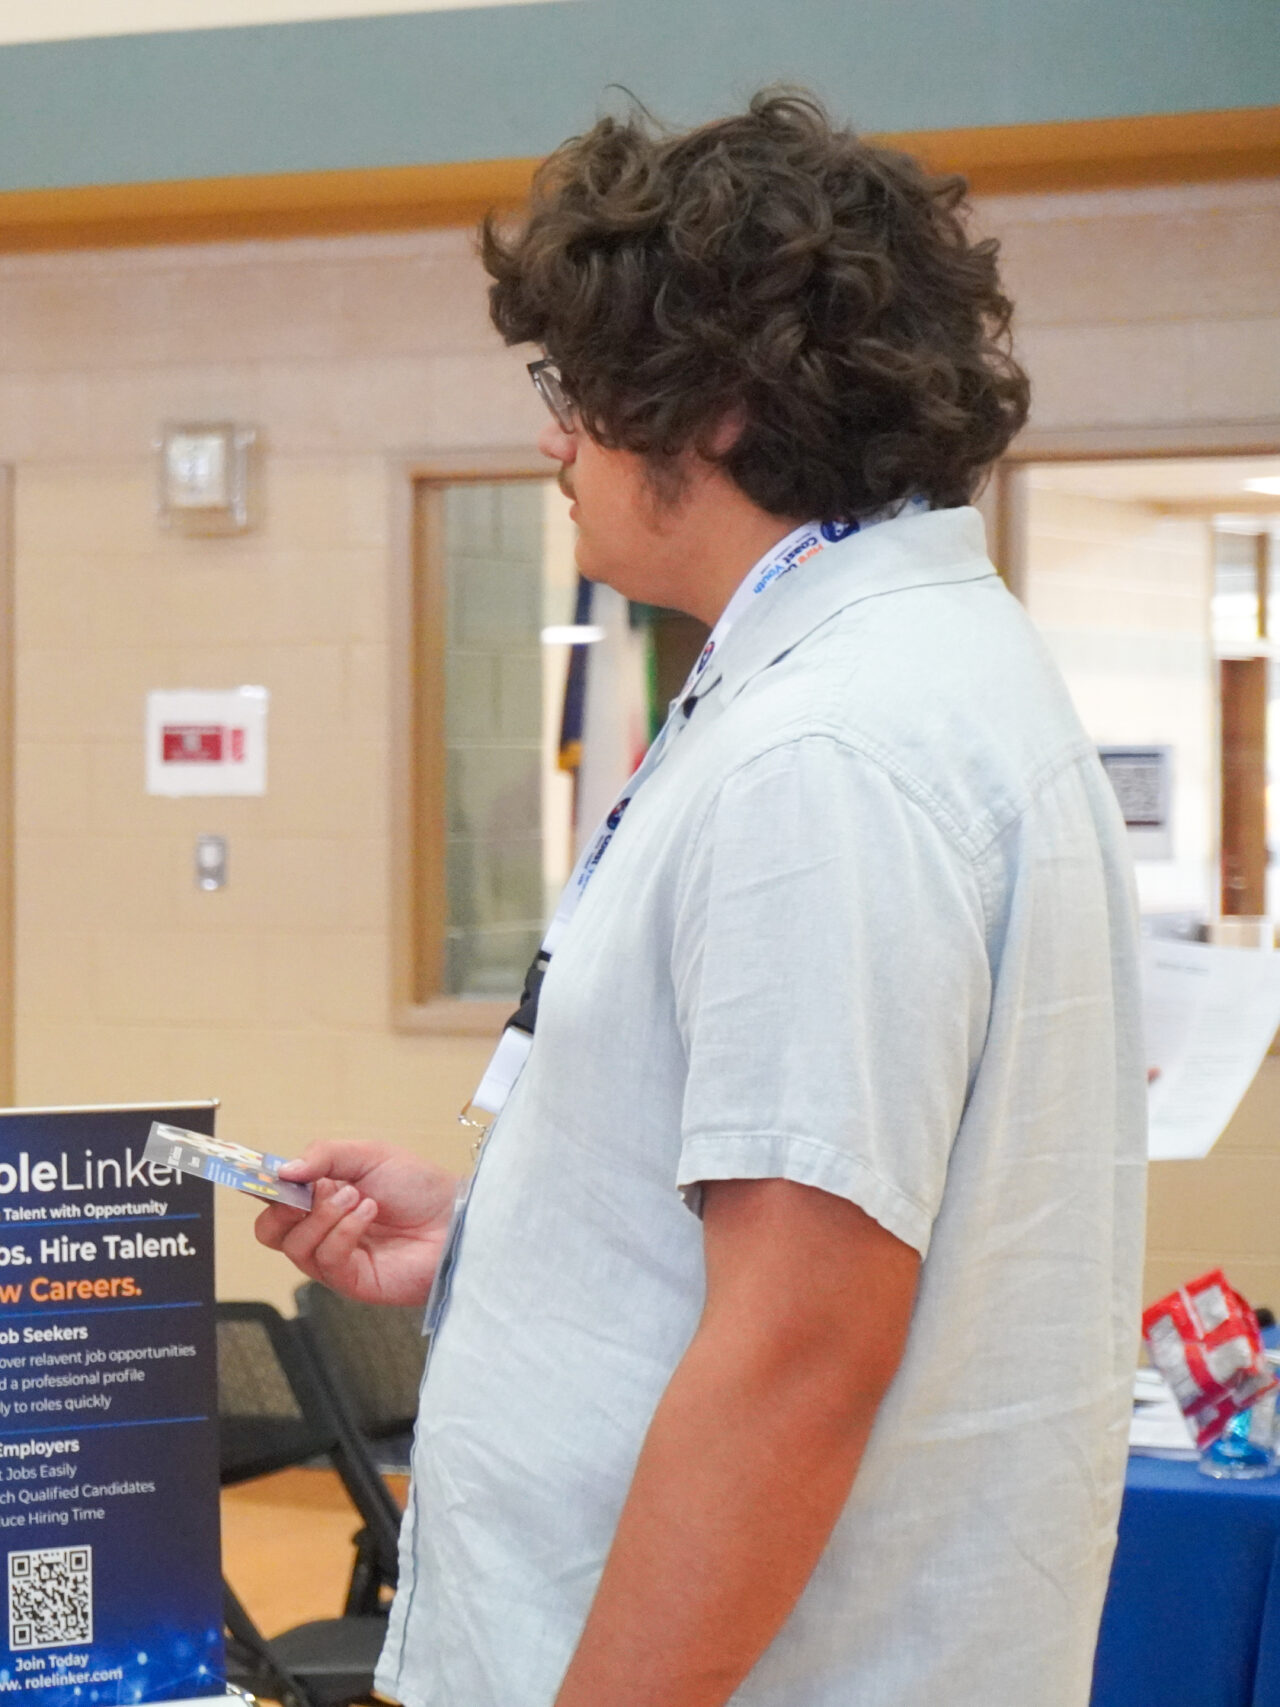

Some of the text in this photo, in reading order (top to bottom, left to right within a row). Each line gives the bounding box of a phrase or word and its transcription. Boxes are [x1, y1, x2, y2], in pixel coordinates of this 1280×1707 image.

[782, 536, 818, 564] Coast
[753, 563, 785, 594] Youth
[3, 1205, 47, 1222] Talent
[49, 1203, 81, 1219] with
[84, 1199, 168, 1220] Opportunity
[40, 1235, 97, 1264] Hire
[102, 1232, 197, 1260] Talent.
[30, 1276, 143, 1303] Careers.
[23, 1324, 89, 1344] Seekers
[84, 1348, 107, 1367] job
[108, 1344, 197, 1364] opportunities
[10, 1381, 19, 1390] a
[21, 1370, 100, 1393] professional
[103, 1368, 146, 1386] profile
[13, 1401, 28, 1414] to
[30, 1398, 63, 1412] roles
[64, 1393, 112, 1412] quickly
[6, 1466, 37, 1481] Jobs
[40, 1462, 78, 1479] Easily
[18, 1485, 80, 1505] Qualified
[82, 1480, 156, 1498] Candidates
[28, 1510, 69, 1526] Hiring
[72, 1507, 106, 1522] Time
[15, 1652, 90, 1673] Join Today
[25, 1667, 124, 1690] rolelinker.com
